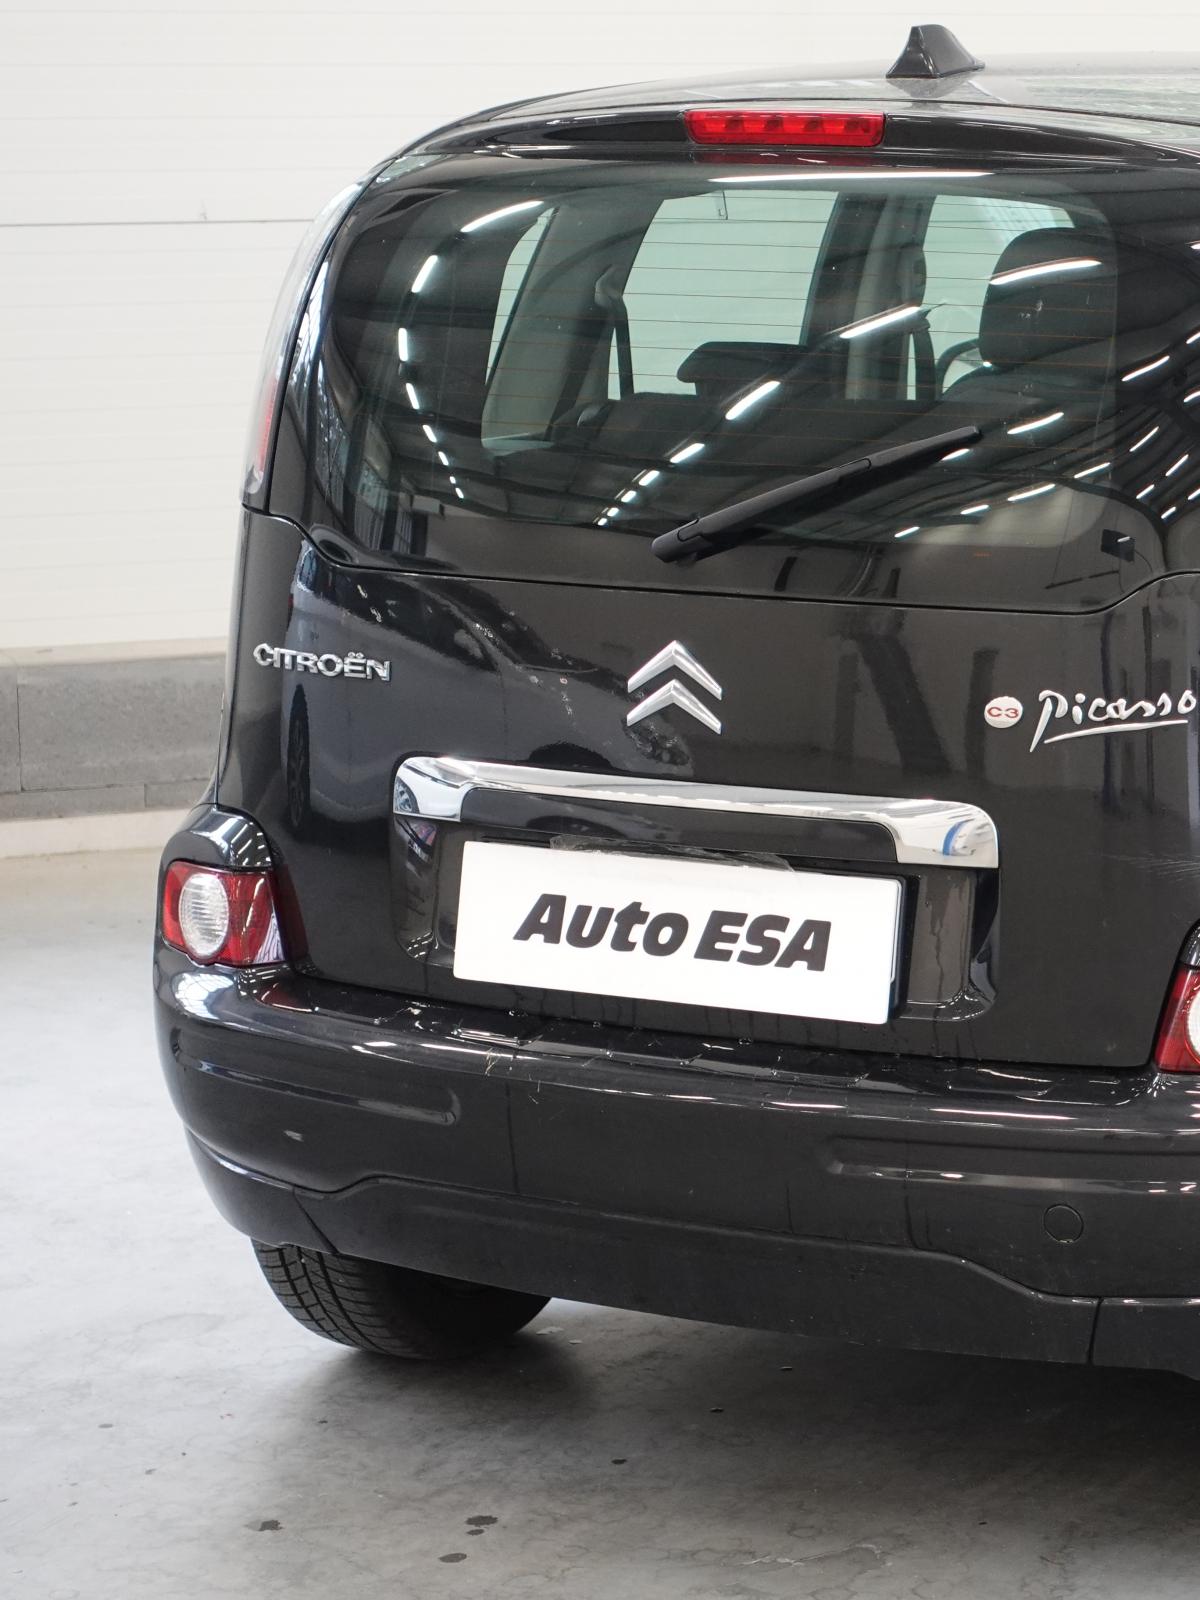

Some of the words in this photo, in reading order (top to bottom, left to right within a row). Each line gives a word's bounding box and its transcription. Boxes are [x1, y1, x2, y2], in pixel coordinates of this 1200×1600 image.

[253, 643, 391, 682] CITROËN
[987, 706, 1019, 719] C3
[513, 893, 689, 957] Auto
[693, 910, 832, 972] ESA
